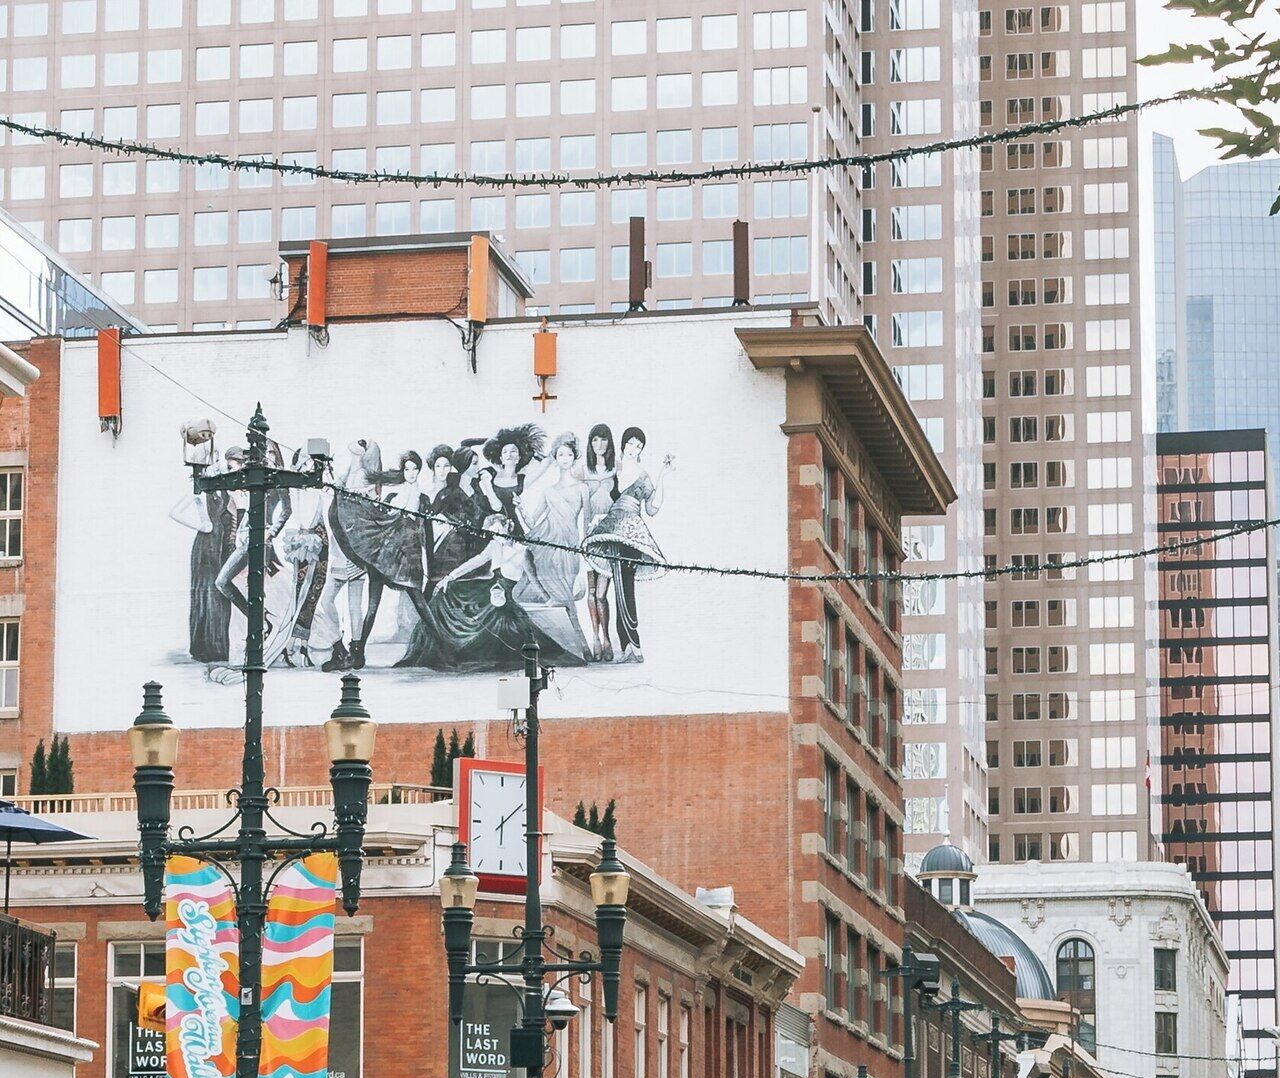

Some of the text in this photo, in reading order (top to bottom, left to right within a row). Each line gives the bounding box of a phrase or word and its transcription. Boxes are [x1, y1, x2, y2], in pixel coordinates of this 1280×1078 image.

[466, 1023, 490, 1035] THE
[136, 1041, 166, 1053] LAS
[466, 1037, 499, 1050] LAST
[466, 1052, 506, 1066] WORD
